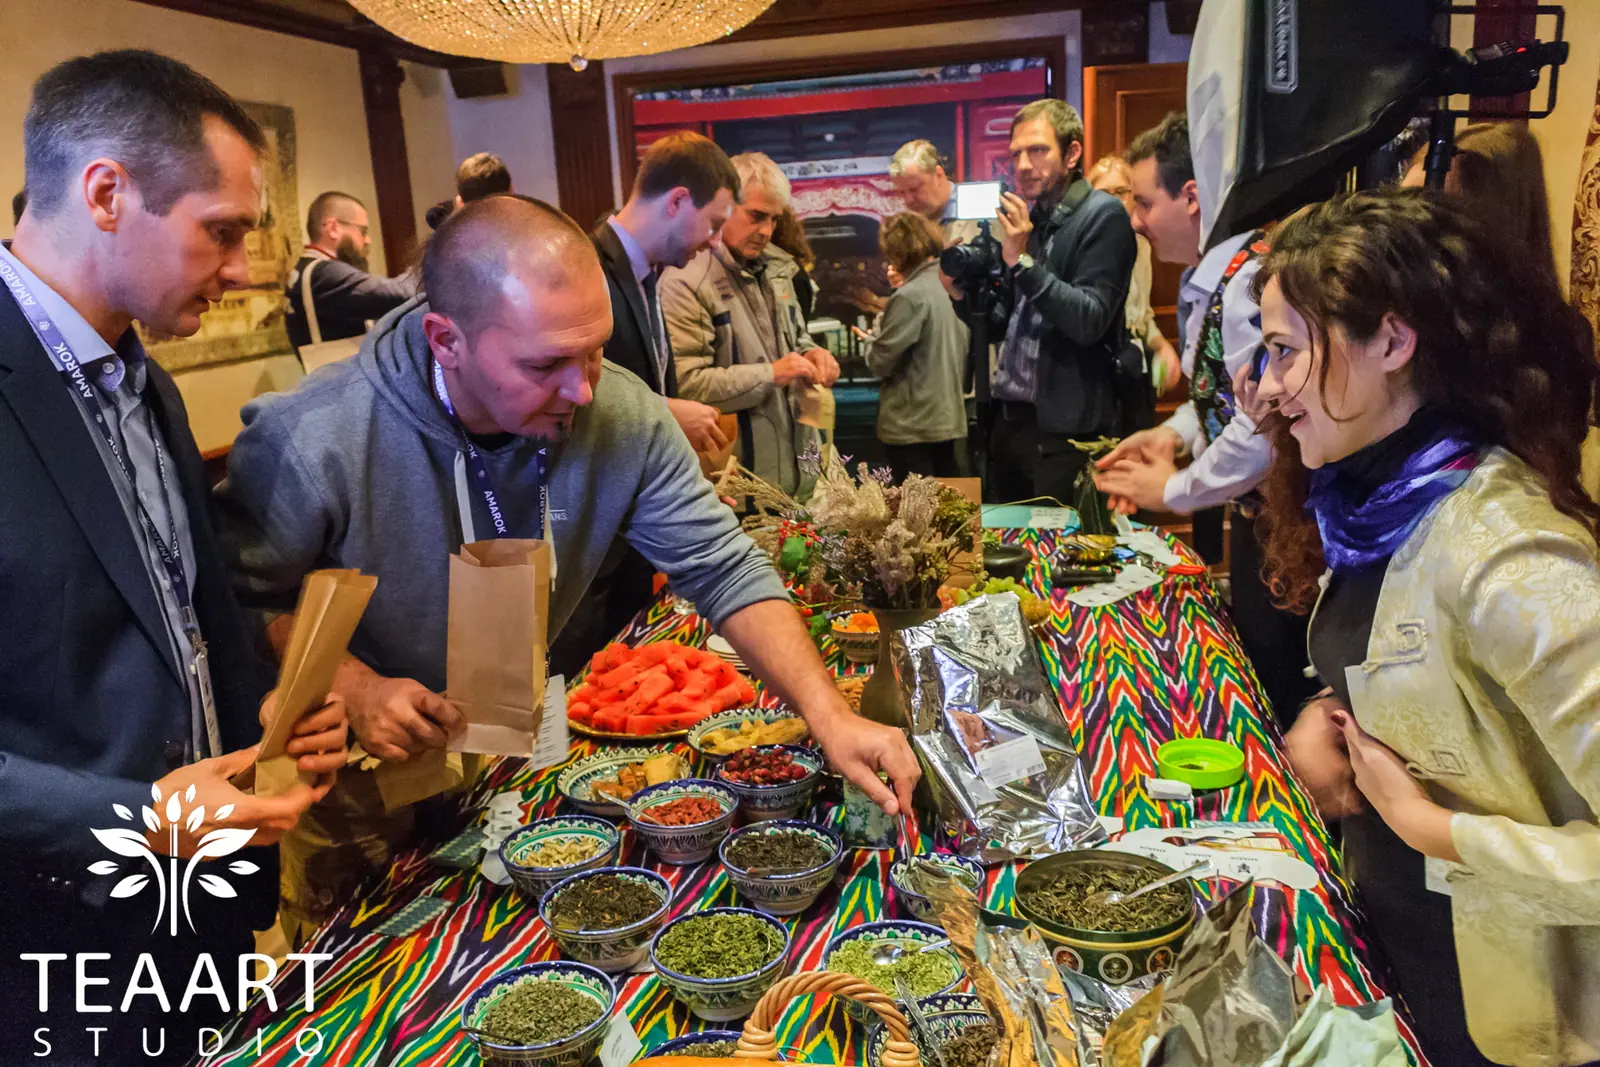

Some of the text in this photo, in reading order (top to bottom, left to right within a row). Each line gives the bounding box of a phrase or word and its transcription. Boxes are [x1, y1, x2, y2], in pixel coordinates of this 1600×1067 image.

[53, 342, 94, 398] AMAROK
[484, 490, 507, 534] AMAROK
[549, 512, 567, 521] ANS
